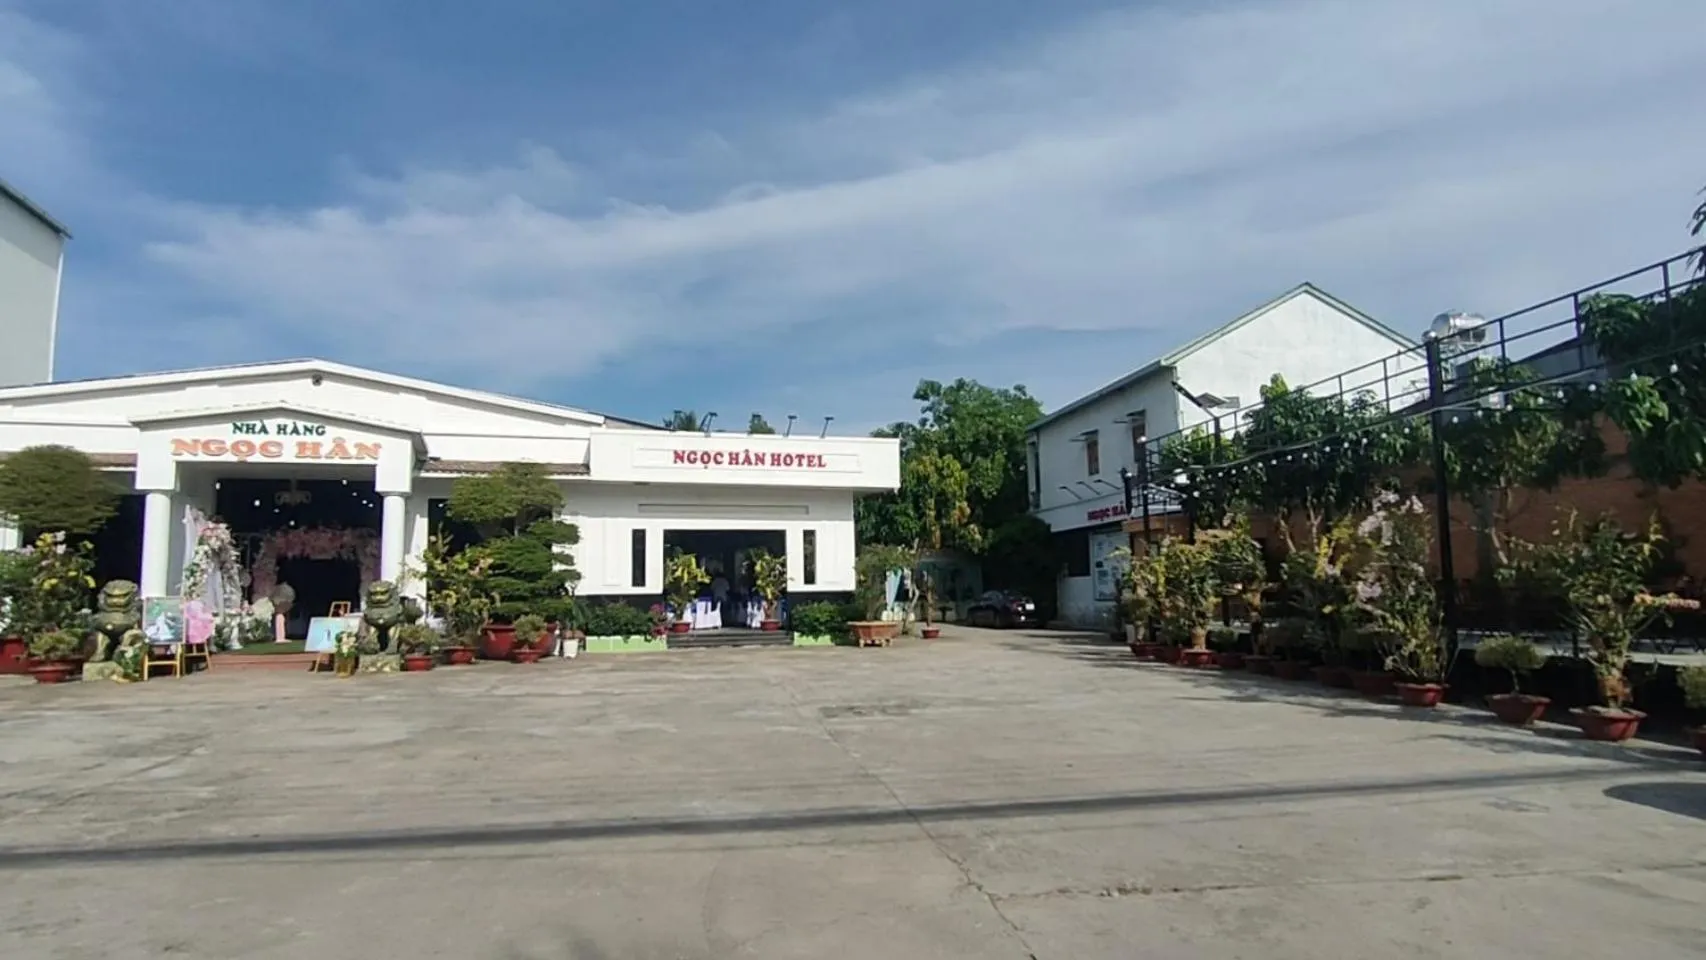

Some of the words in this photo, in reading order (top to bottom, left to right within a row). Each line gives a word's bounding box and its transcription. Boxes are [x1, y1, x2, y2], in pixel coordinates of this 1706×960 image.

[232, 420, 269, 435] NHÀ
[277, 422, 327, 436] HÀNG
[171, 438, 284, 461] NGỌC
[295, 437, 382, 460] HÂN
[673, 450, 724, 469] NGỌC
[728, 449, 766, 466] HÂN
[770, 453, 826, 468] HOTEL
